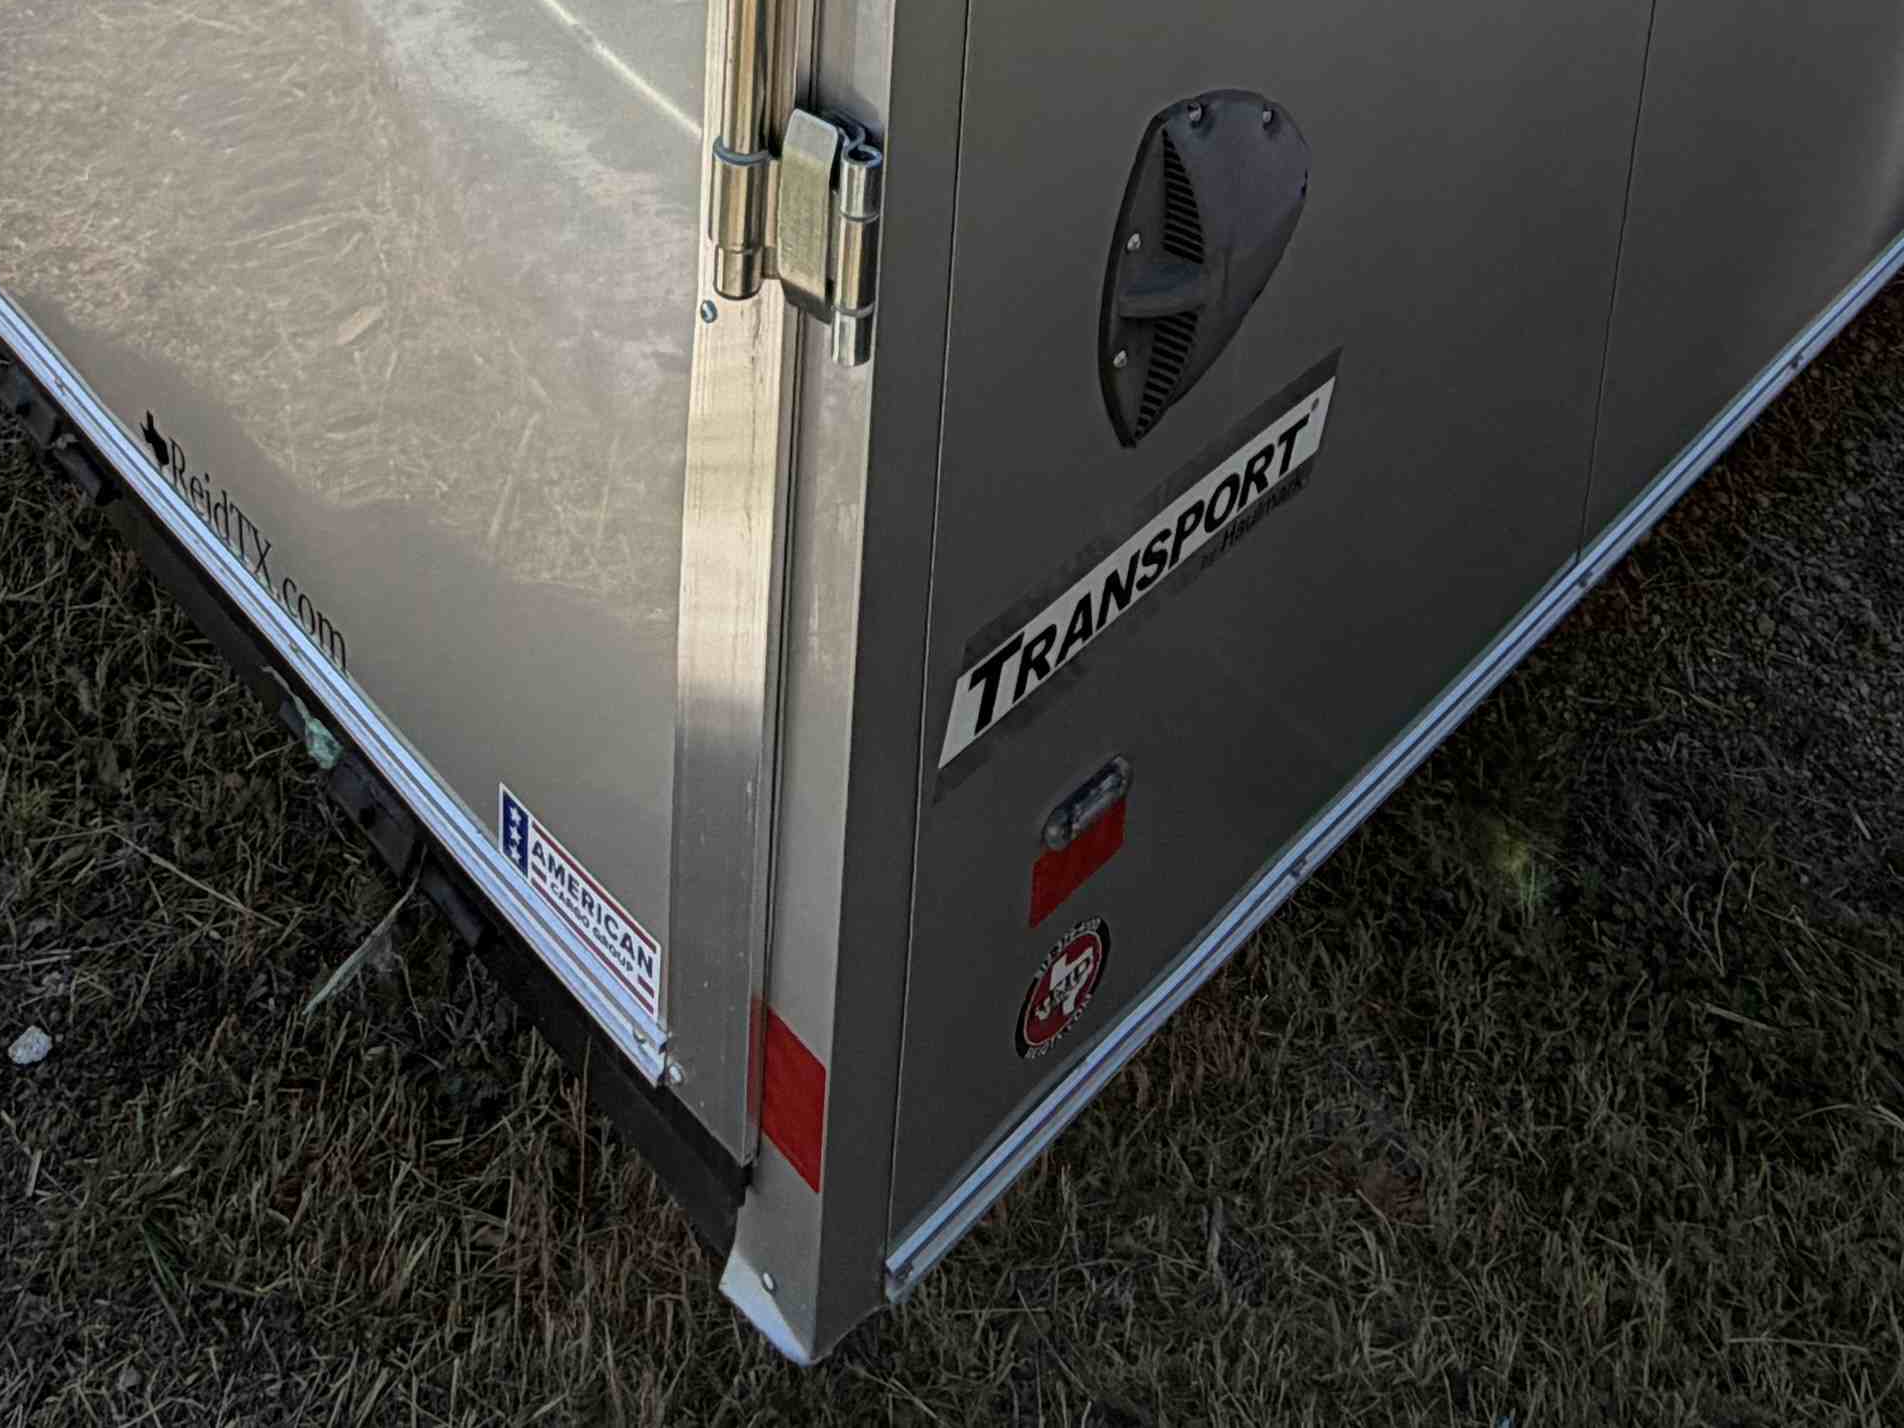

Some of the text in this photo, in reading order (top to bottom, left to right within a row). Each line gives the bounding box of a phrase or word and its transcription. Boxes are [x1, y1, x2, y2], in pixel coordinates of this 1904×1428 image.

[968, 413, 1310, 737] TRANSPORT
[532, 840, 654, 979] AMERICAN
[550, 882, 634, 973] CARGO GROUP
